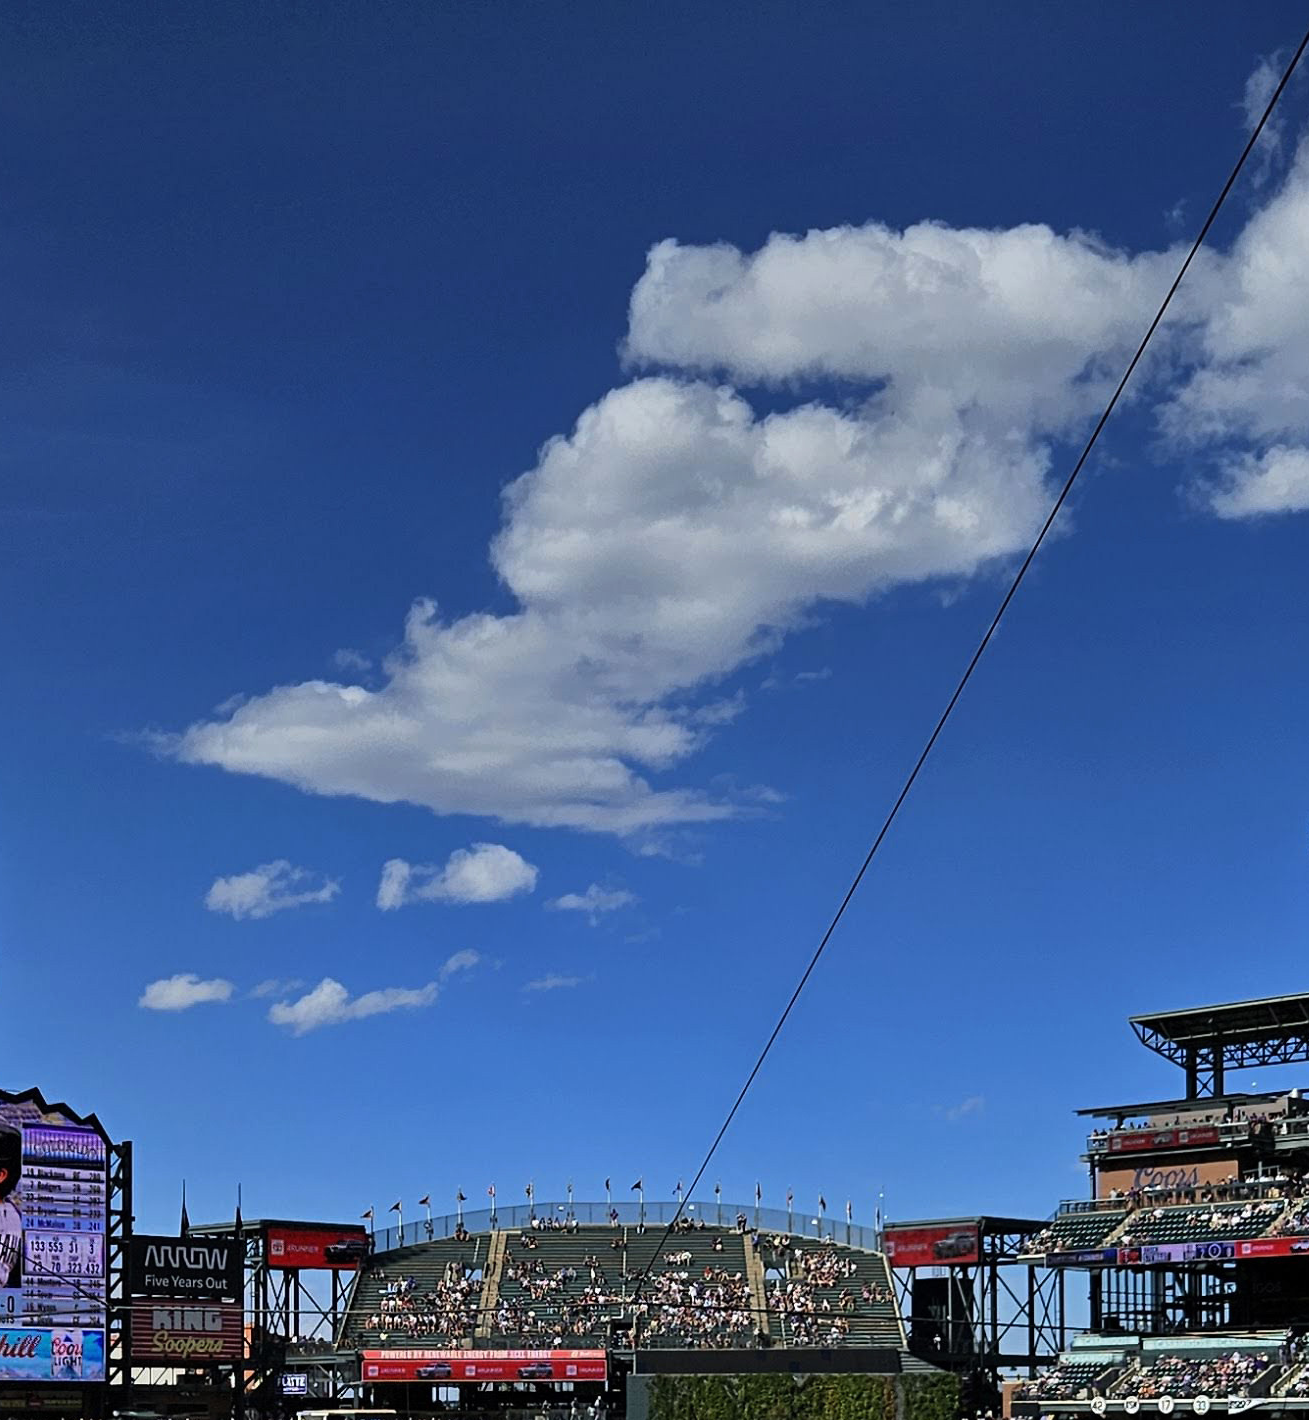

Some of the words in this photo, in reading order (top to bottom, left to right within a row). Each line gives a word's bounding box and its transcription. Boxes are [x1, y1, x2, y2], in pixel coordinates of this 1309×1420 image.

[1132, 1166, 1201, 1188] Coors
[30, 1241, 46, 1253] 133
[49, 1242, 64, 1253] 553
[145, 1245, 228, 1271] ARROW
[145, 1274, 168, 1287] Five
[171, 1275, 203, 1289] Years
[205, 1277, 229, 1289] Out
[152, 1306, 222, 1331] KING
[150, 1330, 225, 1358] Soopers
[381, 1351, 408, 1359] POWERED
[1092, 1400, 1103, 1410] 42
[1161, 1400, 1170, 1410] 17
